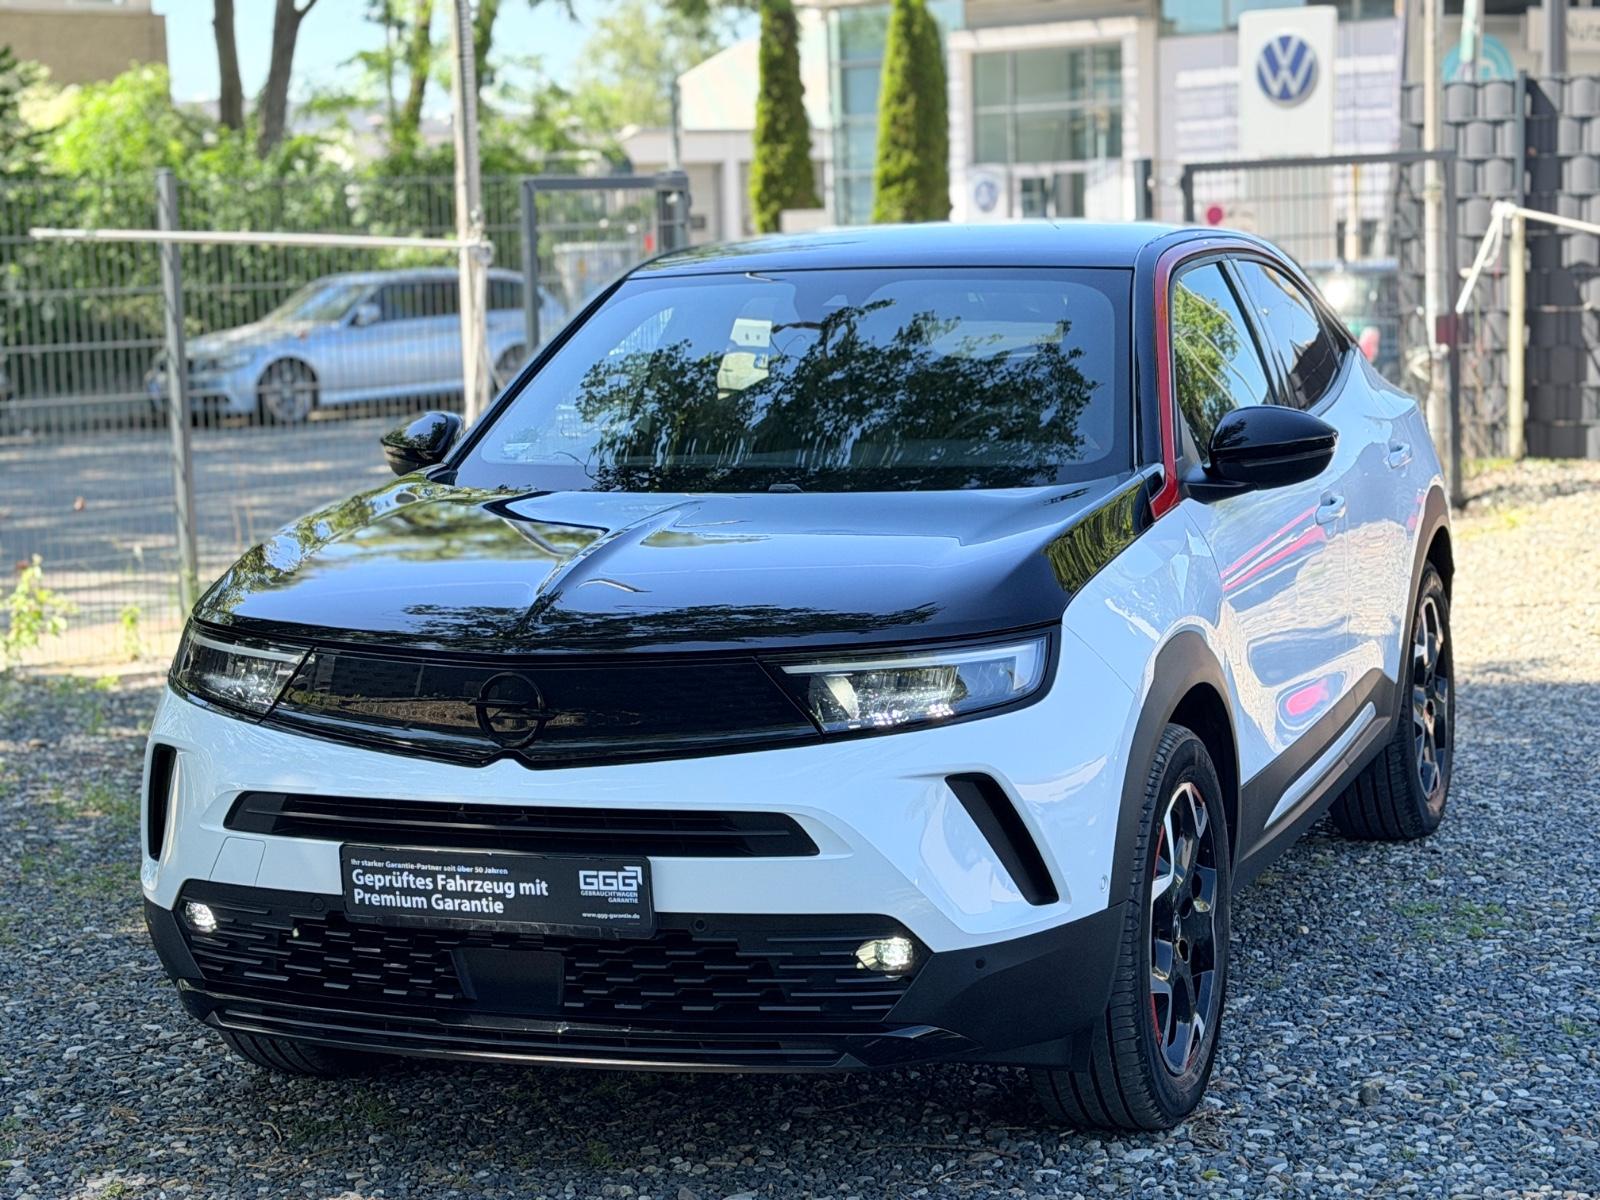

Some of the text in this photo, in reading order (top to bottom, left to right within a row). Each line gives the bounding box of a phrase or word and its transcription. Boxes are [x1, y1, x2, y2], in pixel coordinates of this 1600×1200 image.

[362, 860, 384, 868] starker
[386, 861, 442, 872] Garantie-Partner
[457, 865, 473, 873] über
[352, 869, 548, 898] Geprüftes Fahrzeug mit
[579, 870, 638, 891] GGG
[354, 888, 504, 914] Premium Garantie
